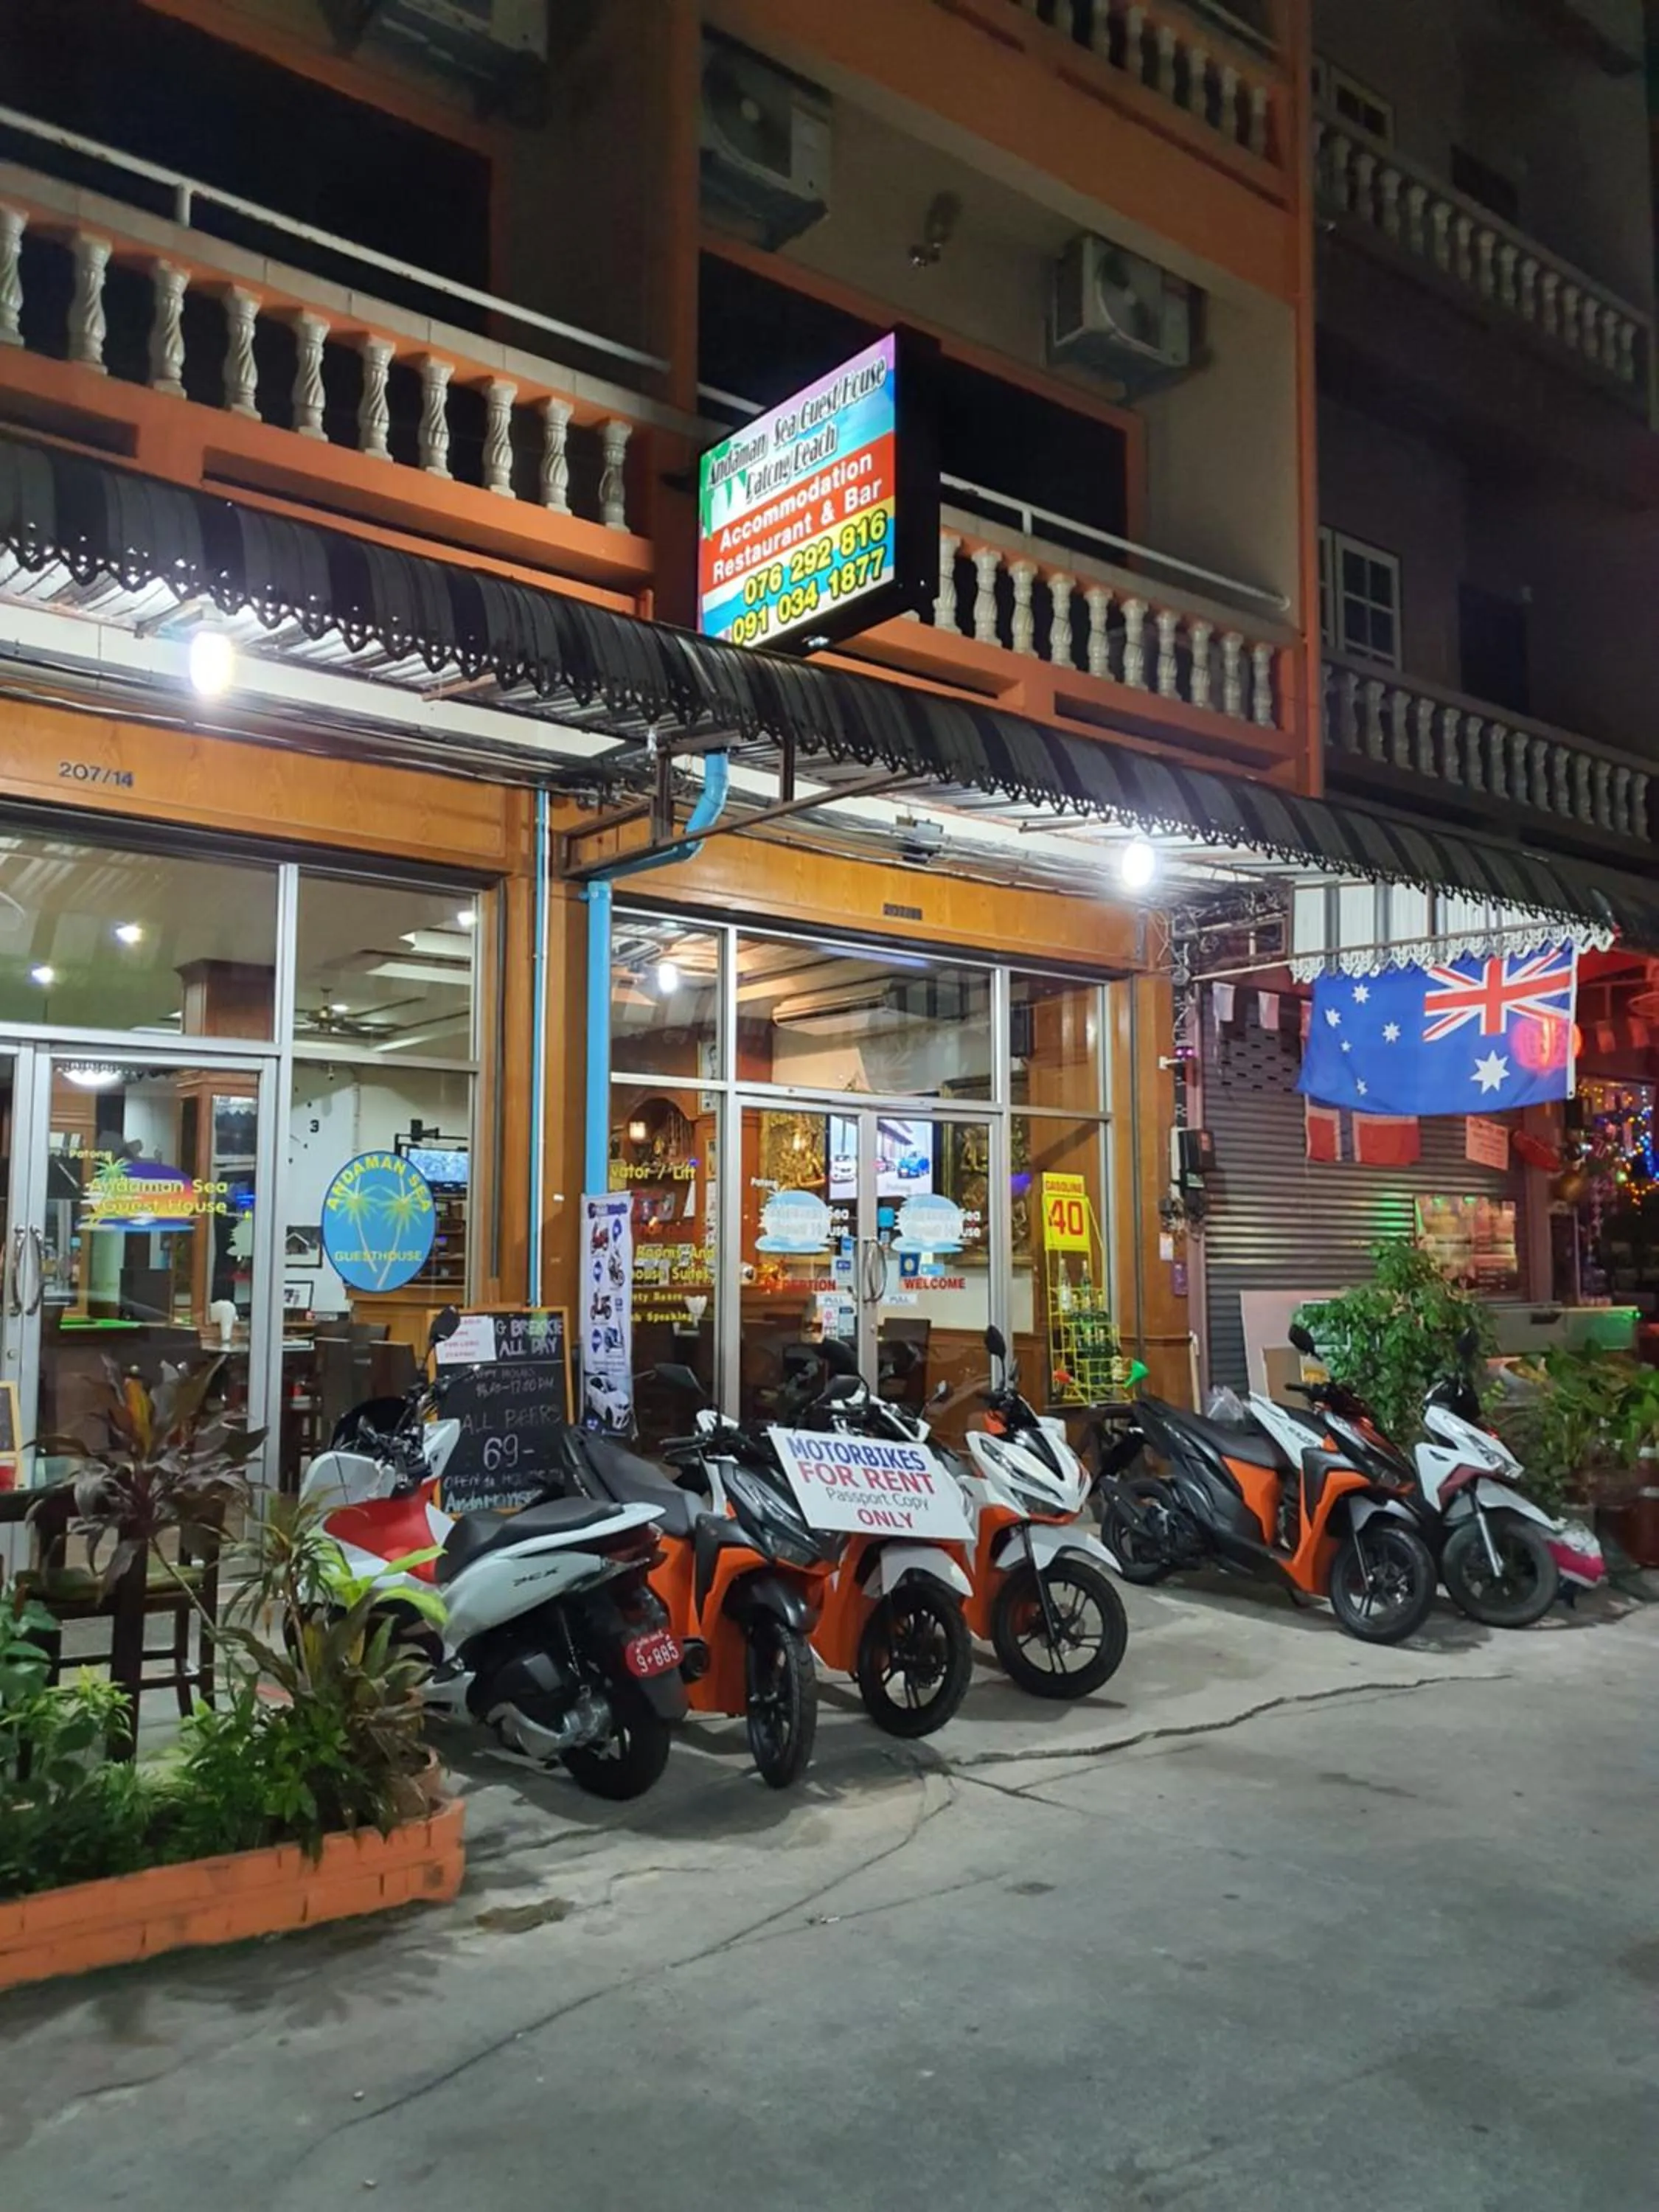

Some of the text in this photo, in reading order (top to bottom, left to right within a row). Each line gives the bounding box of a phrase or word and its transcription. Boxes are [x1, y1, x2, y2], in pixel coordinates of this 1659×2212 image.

[774, 413, 799, 447] Sea
[800, 391, 839, 434] Guest
[841, 355, 886, 404] House
[720, 453, 873, 552] Accommodation
[713, 477, 883, 584] Restaurant & Bar
[743, 508, 888, 607] 076 292 816
[731, 547, 886, 644] 091 034 1877
[59, 762, 133, 788] 207/14
[192, 1178, 229, 1194] Sea
[326, 1155, 432, 1214] ANDAMAN SEA
[168, 1200, 228, 1214] House
[1048, 1200, 1084, 1236] 40
[335, 1250, 423, 1263] GUESTHOUSE
[904, 1277, 967, 1290] WELCOME
[498, 1336, 558, 1358] ALL DAY
[786, 1436, 926, 1472] MOTORBIKES
[796, 1461, 936, 1495] FOR RENT
[824, 1485, 930, 1512] Passport Copy
[857, 1508, 914, 1529] ONLY
